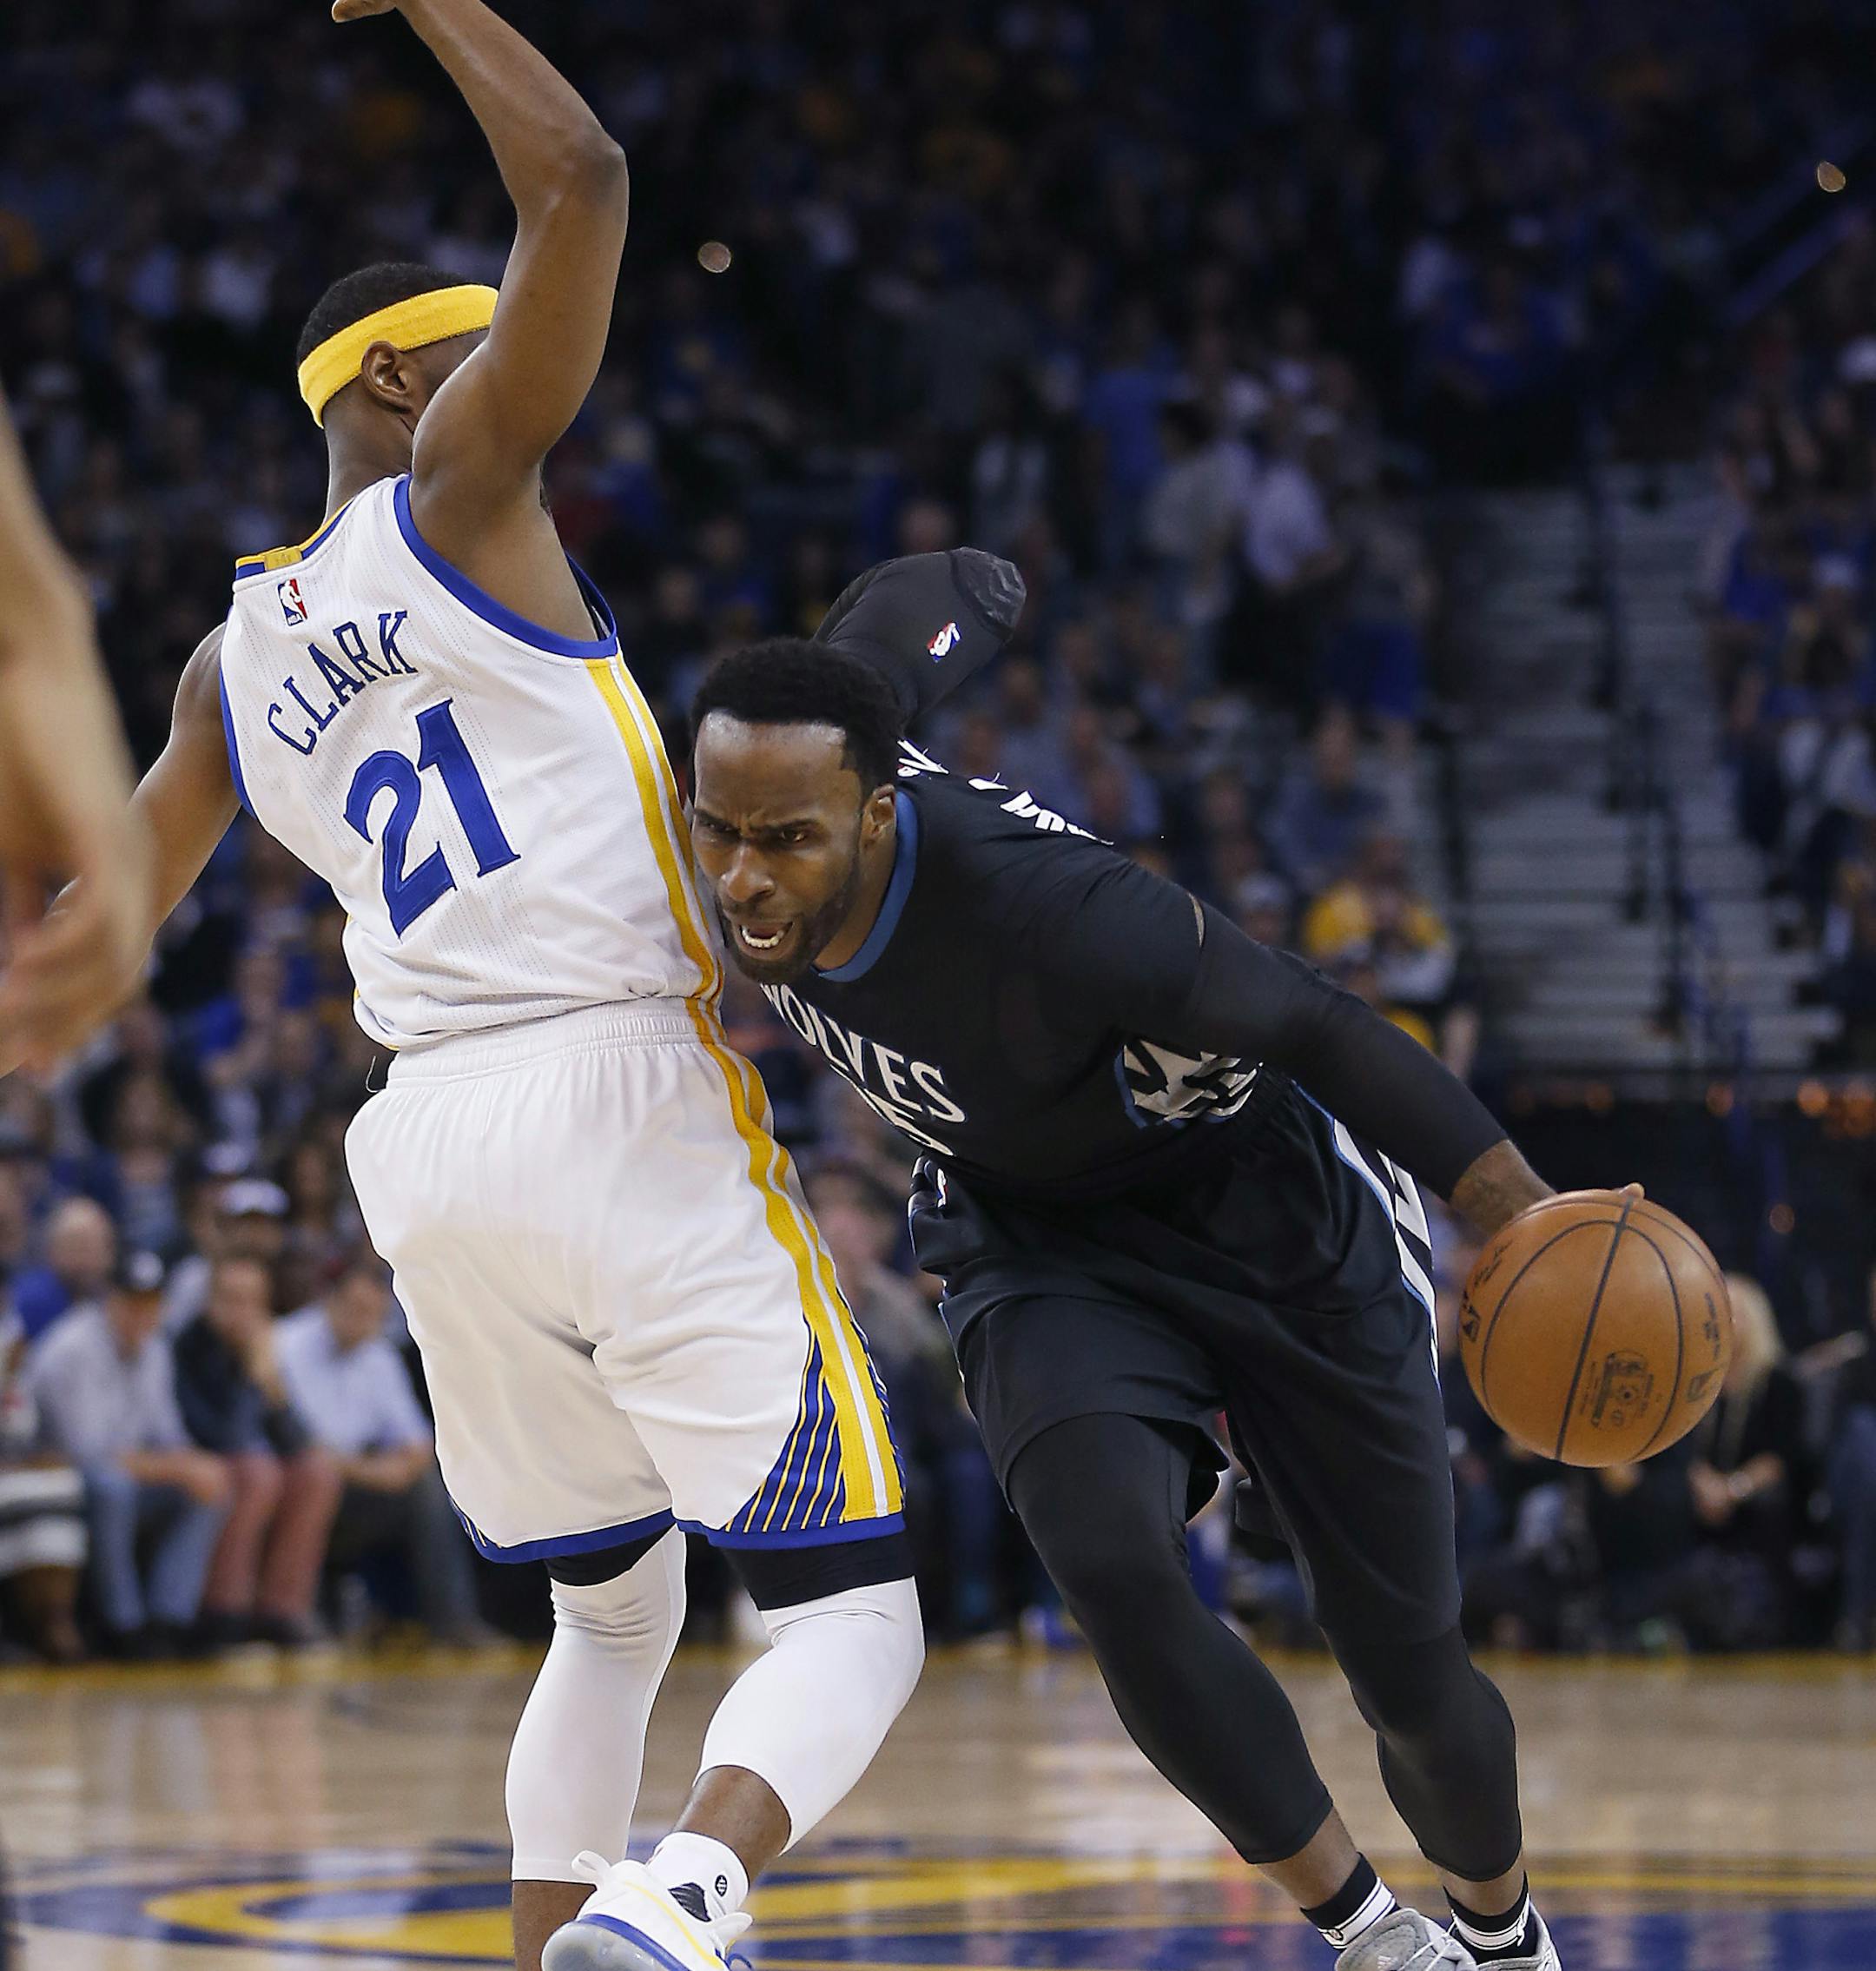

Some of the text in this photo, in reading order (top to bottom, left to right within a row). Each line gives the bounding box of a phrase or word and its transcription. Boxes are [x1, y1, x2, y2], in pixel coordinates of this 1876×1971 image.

[268, 610, 418, 755] CLARK
[343, 698, 521, 941] 21
[759, 983, 966, 1123] WOLVES
